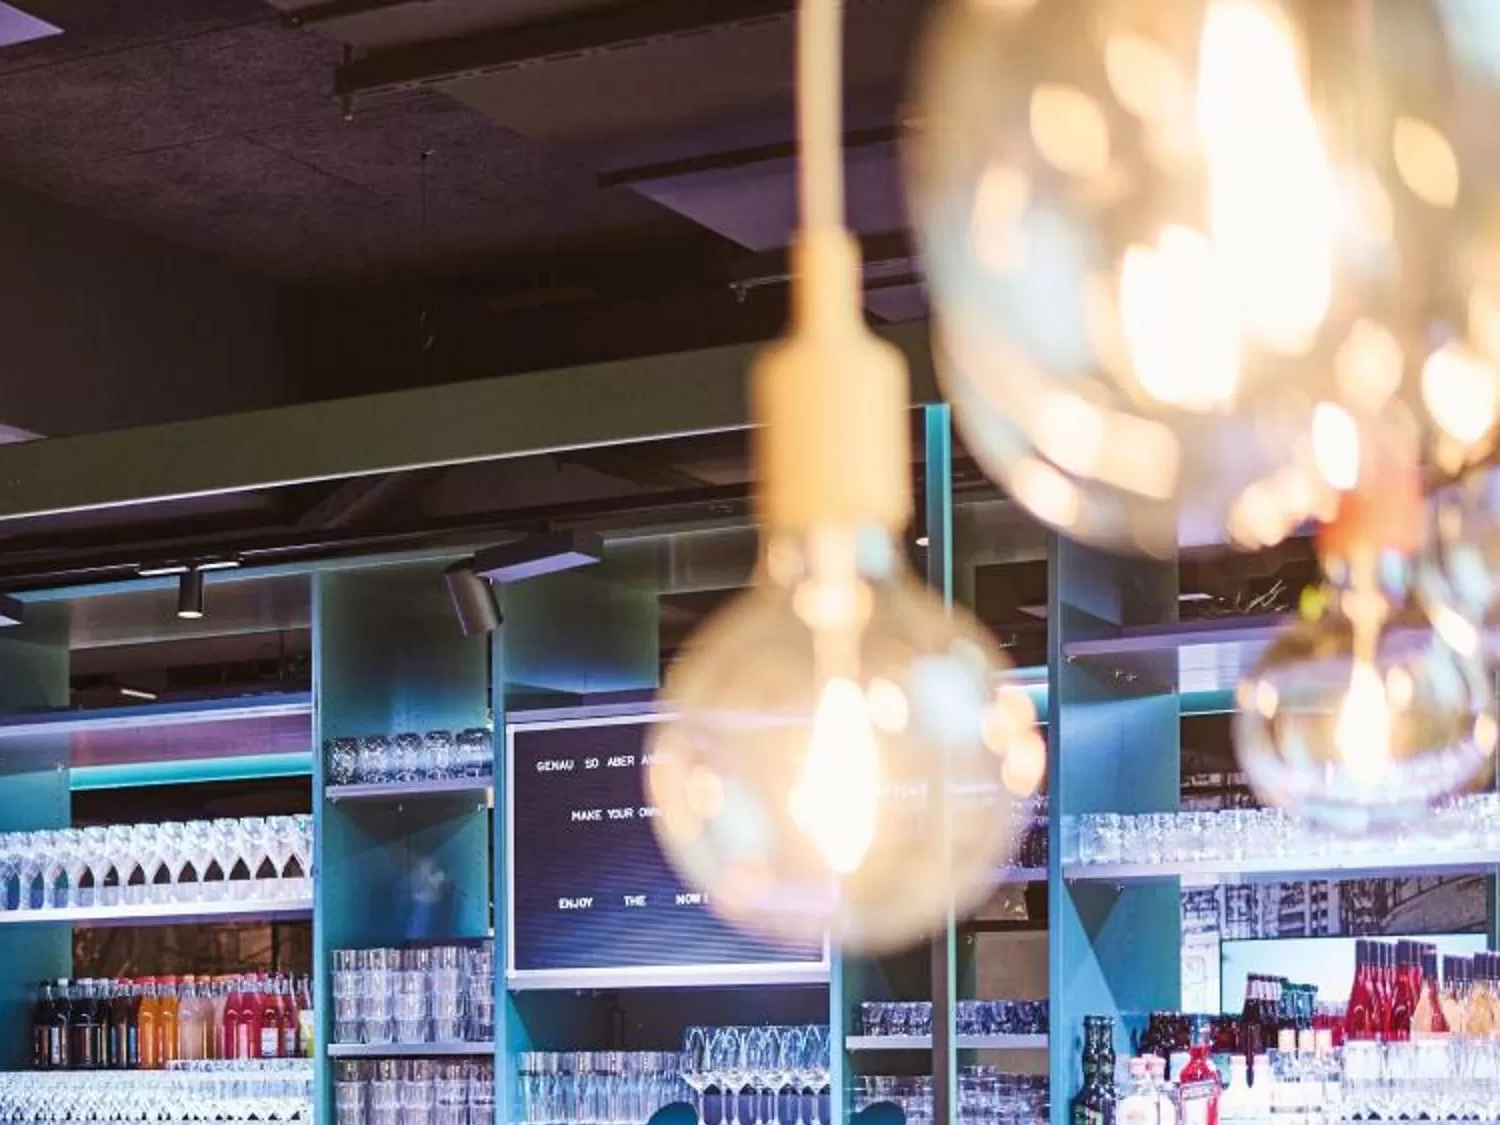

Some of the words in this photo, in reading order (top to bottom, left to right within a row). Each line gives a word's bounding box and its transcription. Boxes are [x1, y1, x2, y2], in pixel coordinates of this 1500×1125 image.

[536, 760, 575, 772] GENAU
[585, 758, 599, 769] SO
[607, 755, 635, 767] ABER
[571, 809, 603, 822] MAKE
[607, 807, 634, 819] YOUR
[558, 897, 593, 909] ENJOY
[623, 895, 647, 907] THE
